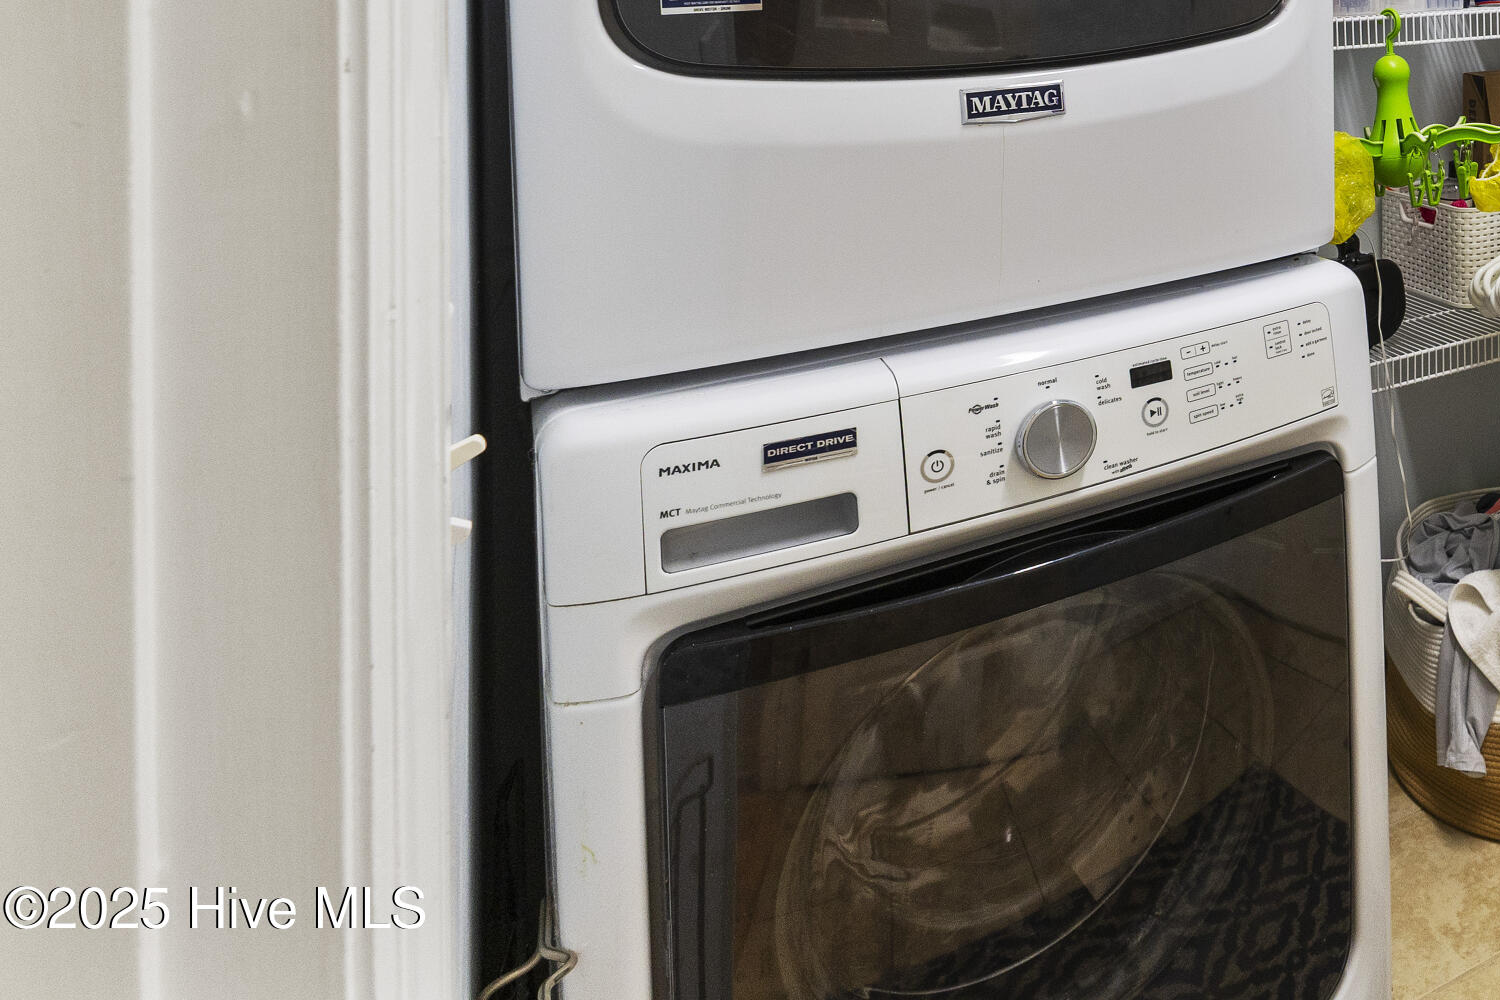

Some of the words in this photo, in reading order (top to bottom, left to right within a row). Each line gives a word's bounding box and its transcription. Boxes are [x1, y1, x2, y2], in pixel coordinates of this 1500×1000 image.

[970, 90, 1059, 113] MAYTAG
[1037, 377, 1058, 386] normal
[1098, 396, 1122, 406] delicates
[985, 424, 1001, 433] rapid
[985, 431, 1002, 439] wash
[767, 442, 814, 457] DIRECT
[816, 434, 855, 448] DRIVE
[980, 447, 1003, 457] sanitize
[659, 459, 720, 477] MAXIMA
[1103, 463, 1119, 471] clean
[1119, 457, 1139, 467] washer
[989, 469, 1005, 478] drain
[992, 476, 1006, 485] spin
[659, 508, 681, 519] MCT
[685, 505, 709, 515] Maytag
[710, 498, 747, 510] Commercial
[748, 493, 783, 503] Technology
